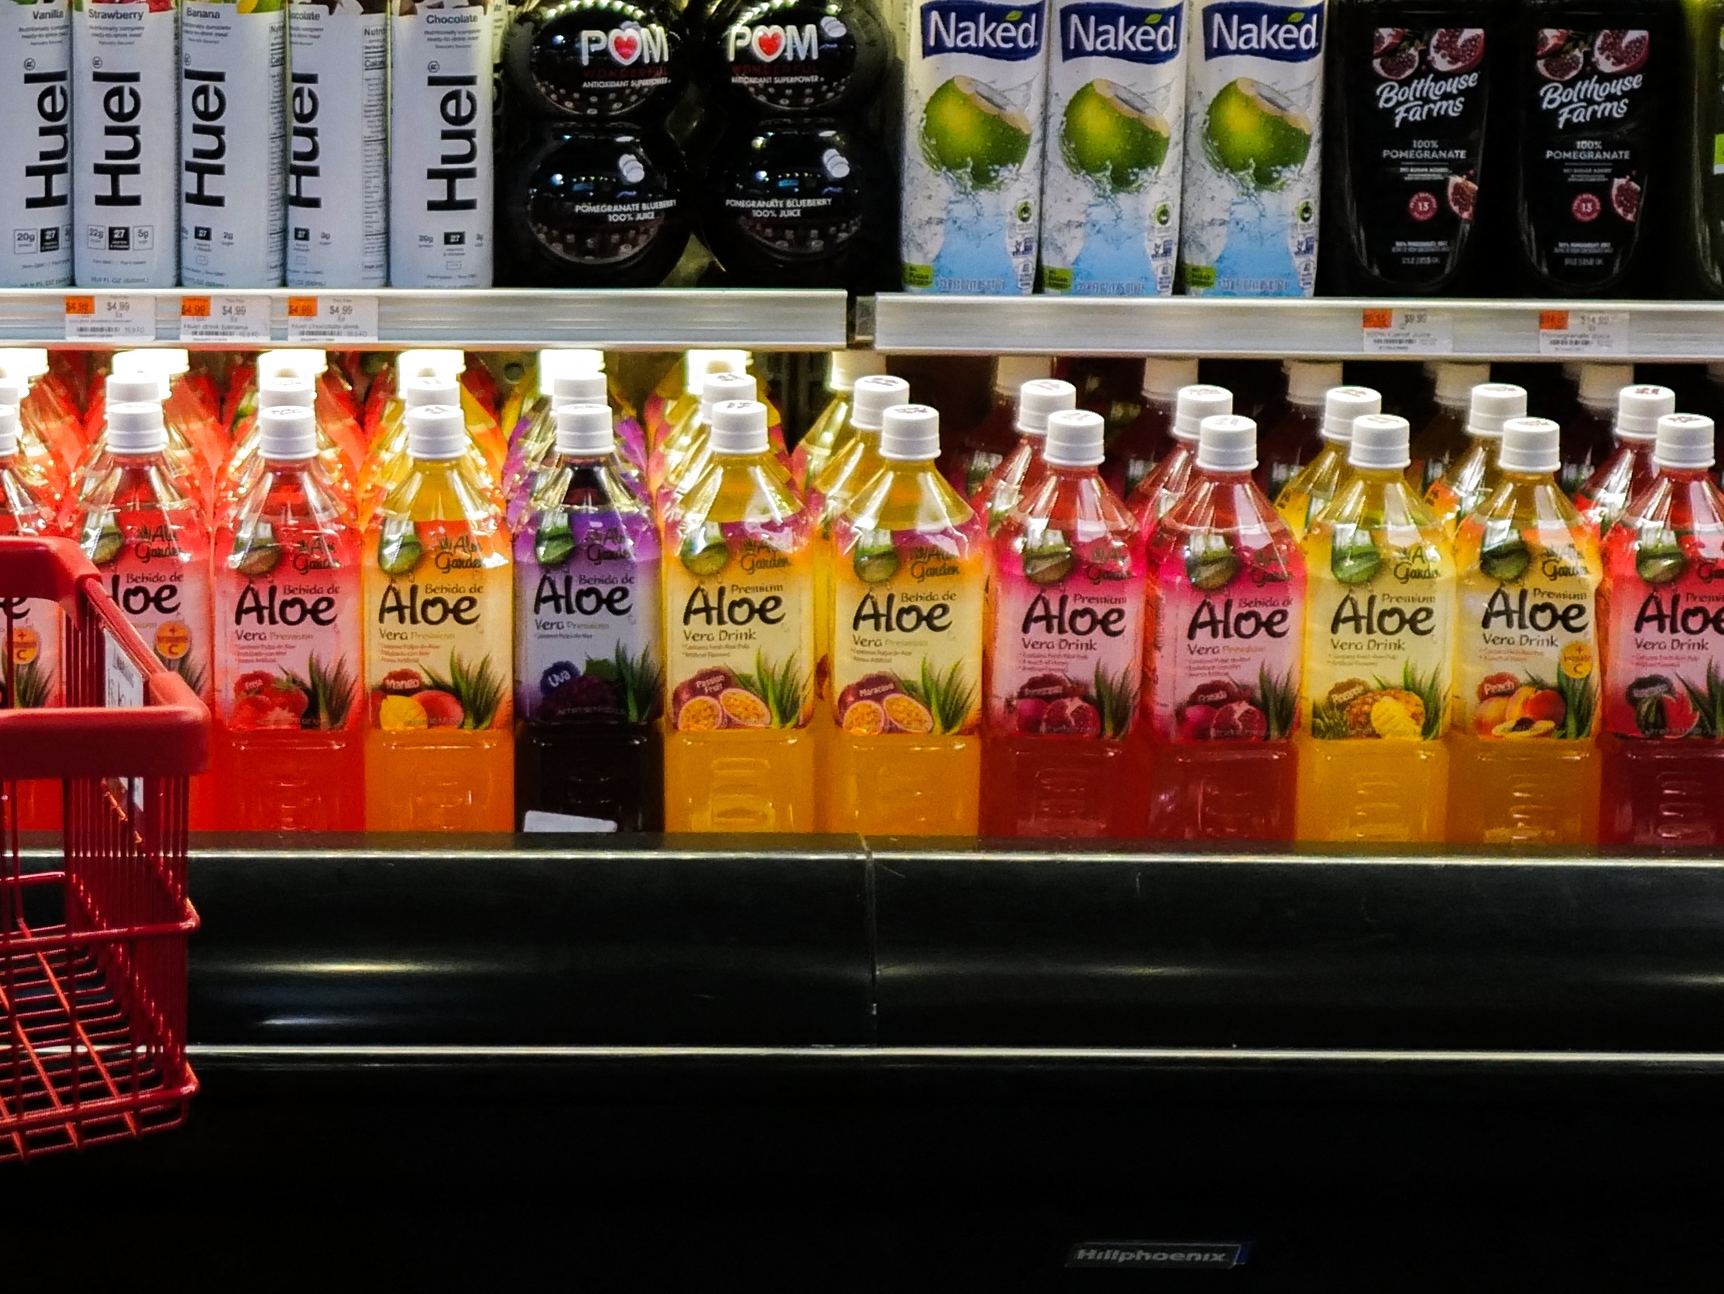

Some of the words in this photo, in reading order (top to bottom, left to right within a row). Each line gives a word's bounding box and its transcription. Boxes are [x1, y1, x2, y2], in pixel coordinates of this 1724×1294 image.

[88, 10, 144, 23] Strawberry
[426, 13, 479, 25] Chocolate
[929, 11, 1037, 50] Naked
[1068, 14, 1175, 53] Naked
[1212, 13, 1318, 51] Naked
[1376, 72, 1479, 110] Bolthouse
[1540, 73, 1644, 111] Bolthouse
[1394, 95, 1464, 128] Farms
[1557, 97, 1629, 129] Farms
[92, 70, 141, 207] Huel
[184, 69, 226, 208] Huel
[426, 74, 478, 211] Huel
[1382, 150, 1467, 160] POMEGRANATE
[1546, 150, 1630, 160] POMEGRANATE
[778, 209, 802, 218] JUICE
[234, 584, 337, 626] Aloe
[377, 584, 481, 627] Aloe
[532, 574, 633, 617] Aloe
[682, 584, 787, 627] Aloe
[851, 591, 954, 634] Aloe
[1481, 588, 1588, 634] Aloe
[235, 629, 268, 642] Vera
[682, 629, 716, 642] Vera
[719, 628, 757, 641] Drink
[1022, 594, 1127, 639] Aloe
[1187, 598, 1290, 641] Aloe
[1330, 595, 1436, 639] Aloe
[1330, 638, 1364, 652] Vera
[1368, 638, 1405, 652] Drink
[1077, 1248, 1228, 1264] Hillphoenix
